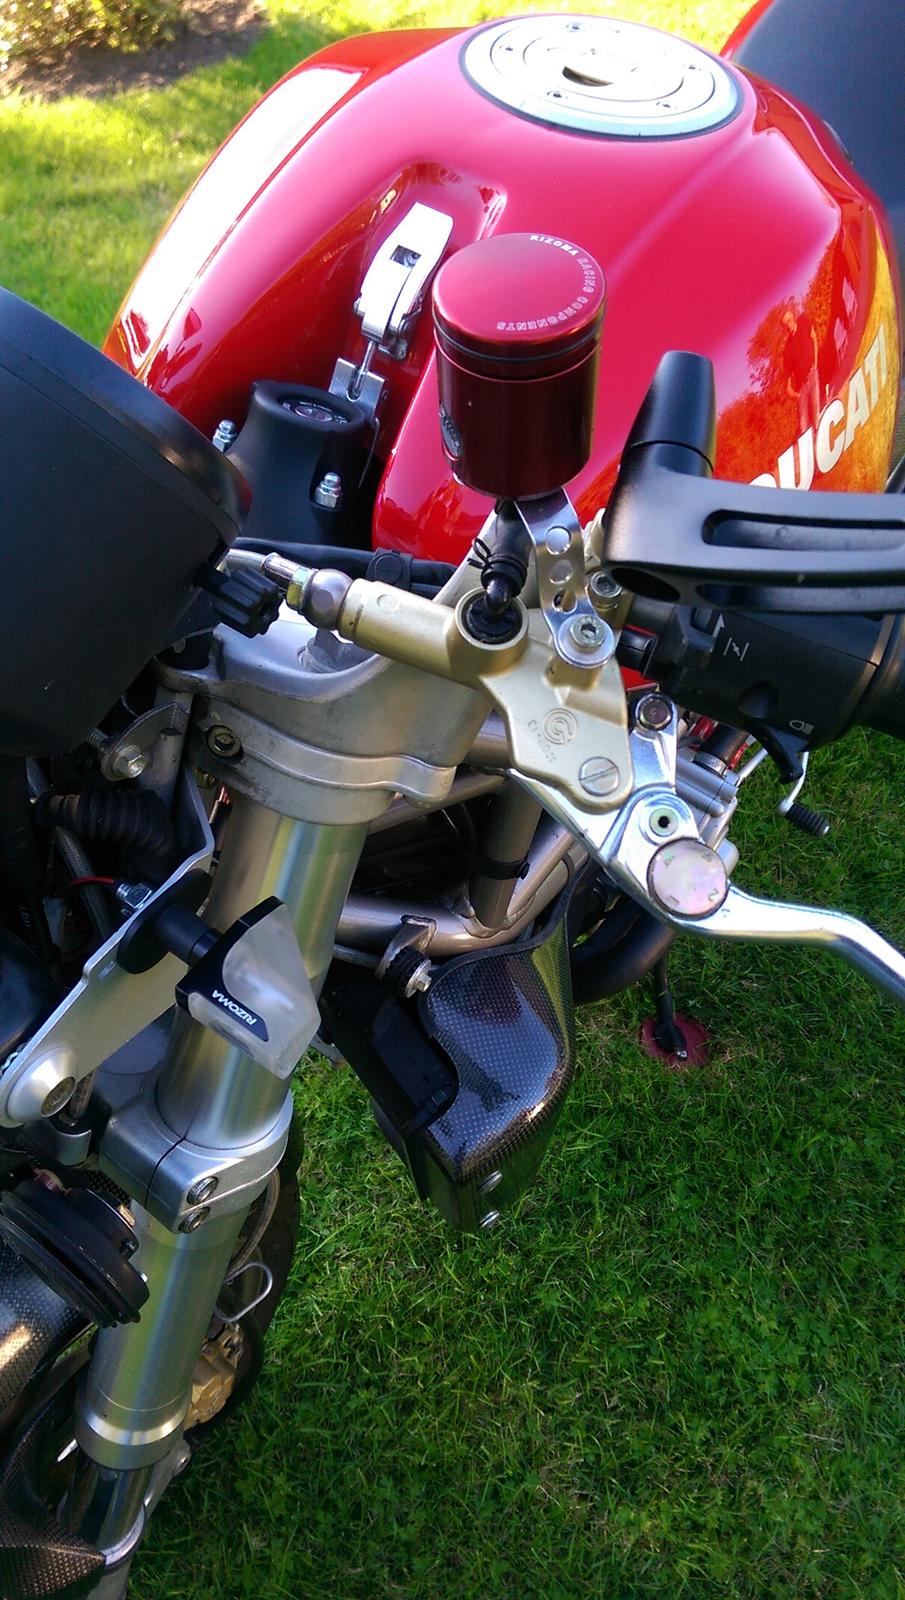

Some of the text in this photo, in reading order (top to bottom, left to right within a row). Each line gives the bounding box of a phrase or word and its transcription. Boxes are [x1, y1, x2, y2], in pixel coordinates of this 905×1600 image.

[496, 234, 596, 331] RIZOMA RACING COMPONENTS
[212, 989, 258, 1026] RIZOMA
